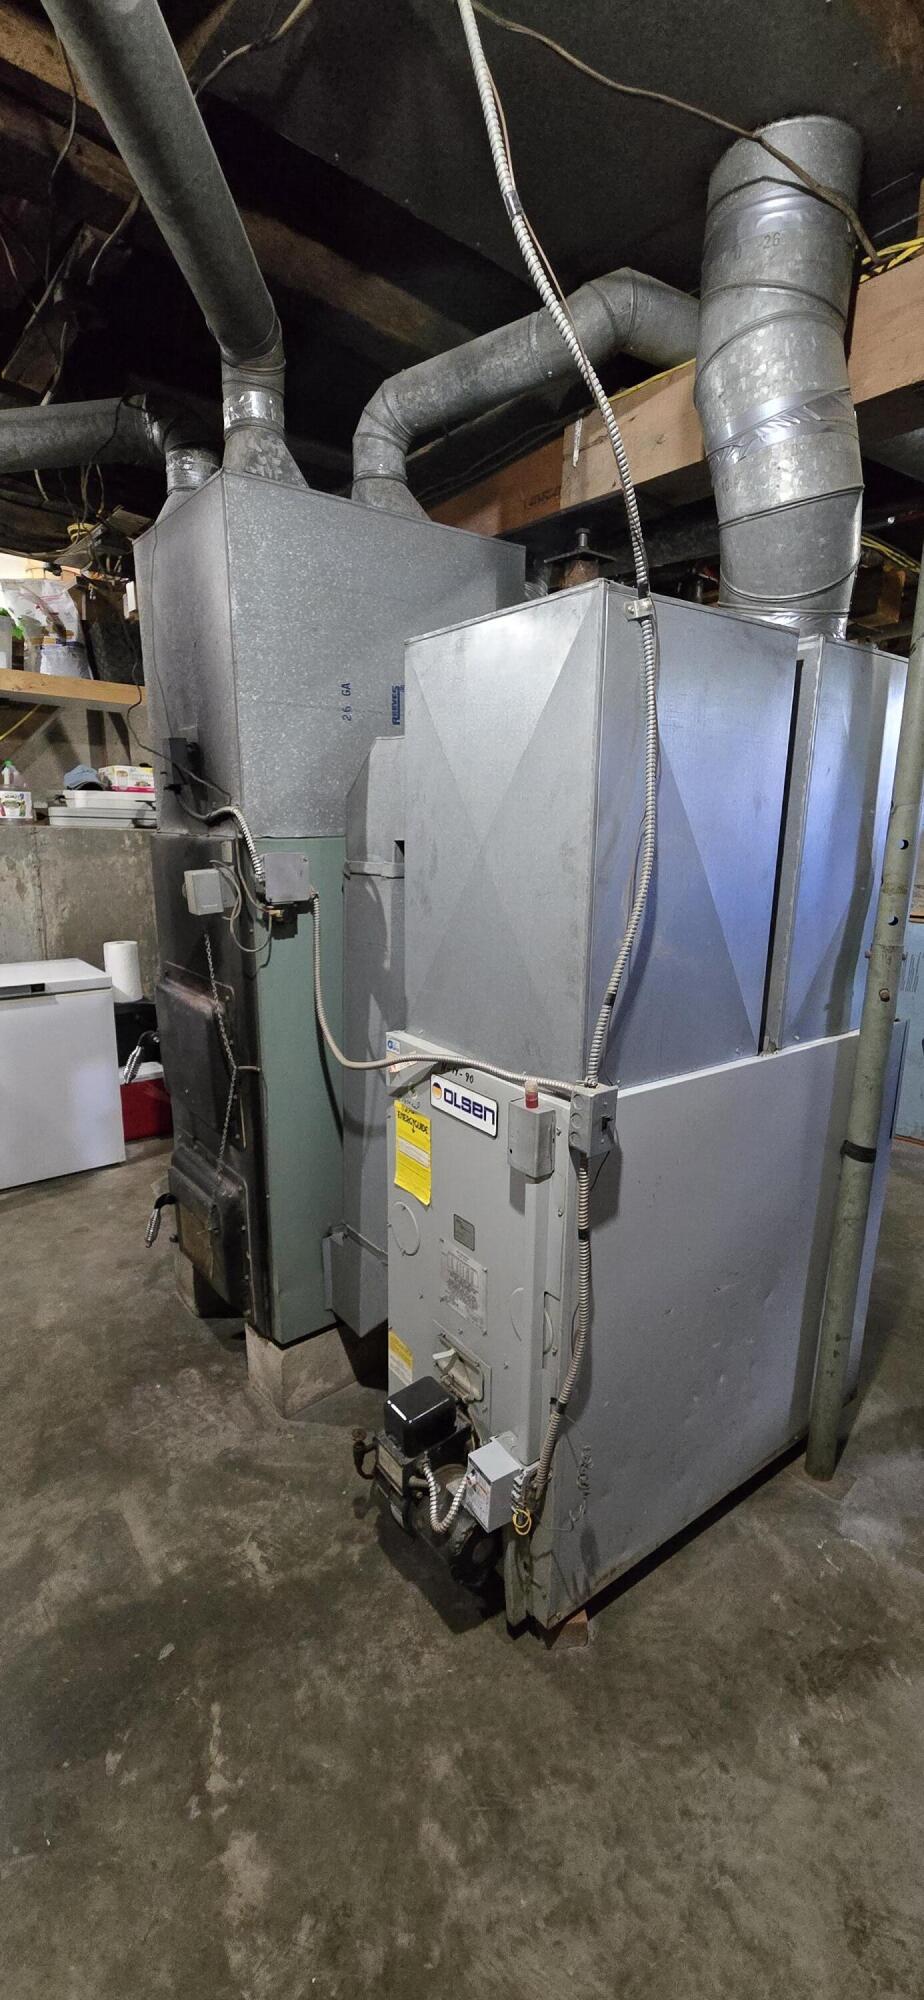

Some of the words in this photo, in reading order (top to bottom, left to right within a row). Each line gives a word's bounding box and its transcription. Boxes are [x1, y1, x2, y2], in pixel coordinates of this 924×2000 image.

[763, 232, 781, 249] 26
[341, 682, 351, 697] GA
[342, 705, 352, 721] 26
